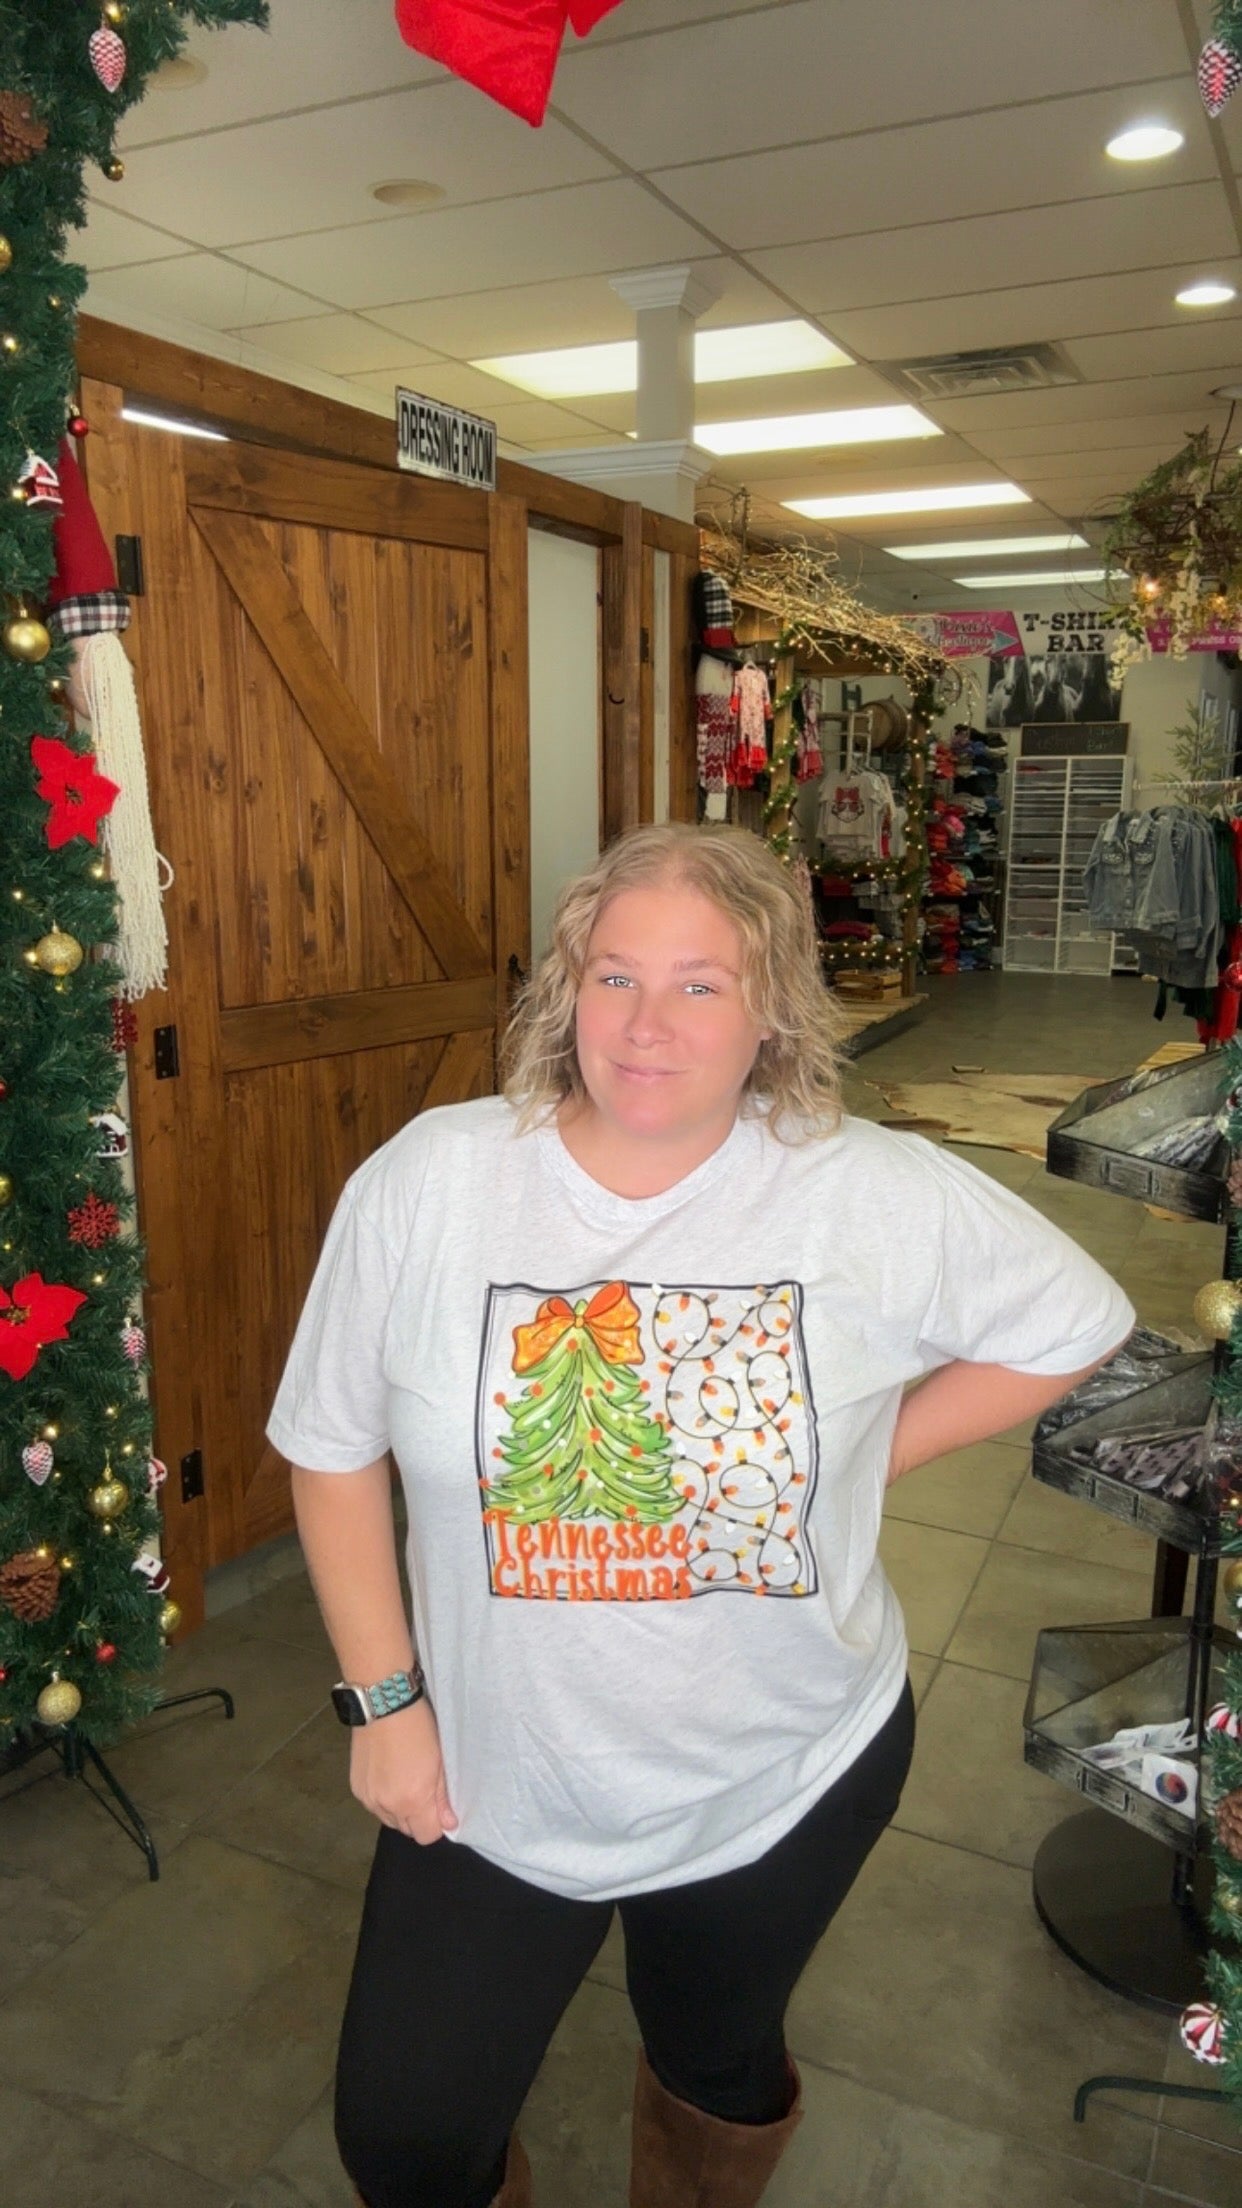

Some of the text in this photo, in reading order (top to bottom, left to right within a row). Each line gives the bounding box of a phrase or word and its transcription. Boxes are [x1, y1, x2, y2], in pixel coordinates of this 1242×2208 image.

[401, 401, 493, 483] DRESSING ROOM
[1046, 633, 1106, 653] BAR
[484, 1508, 693, 1561] Tennessee
[493, 1552, 693, 1601] Christmas
